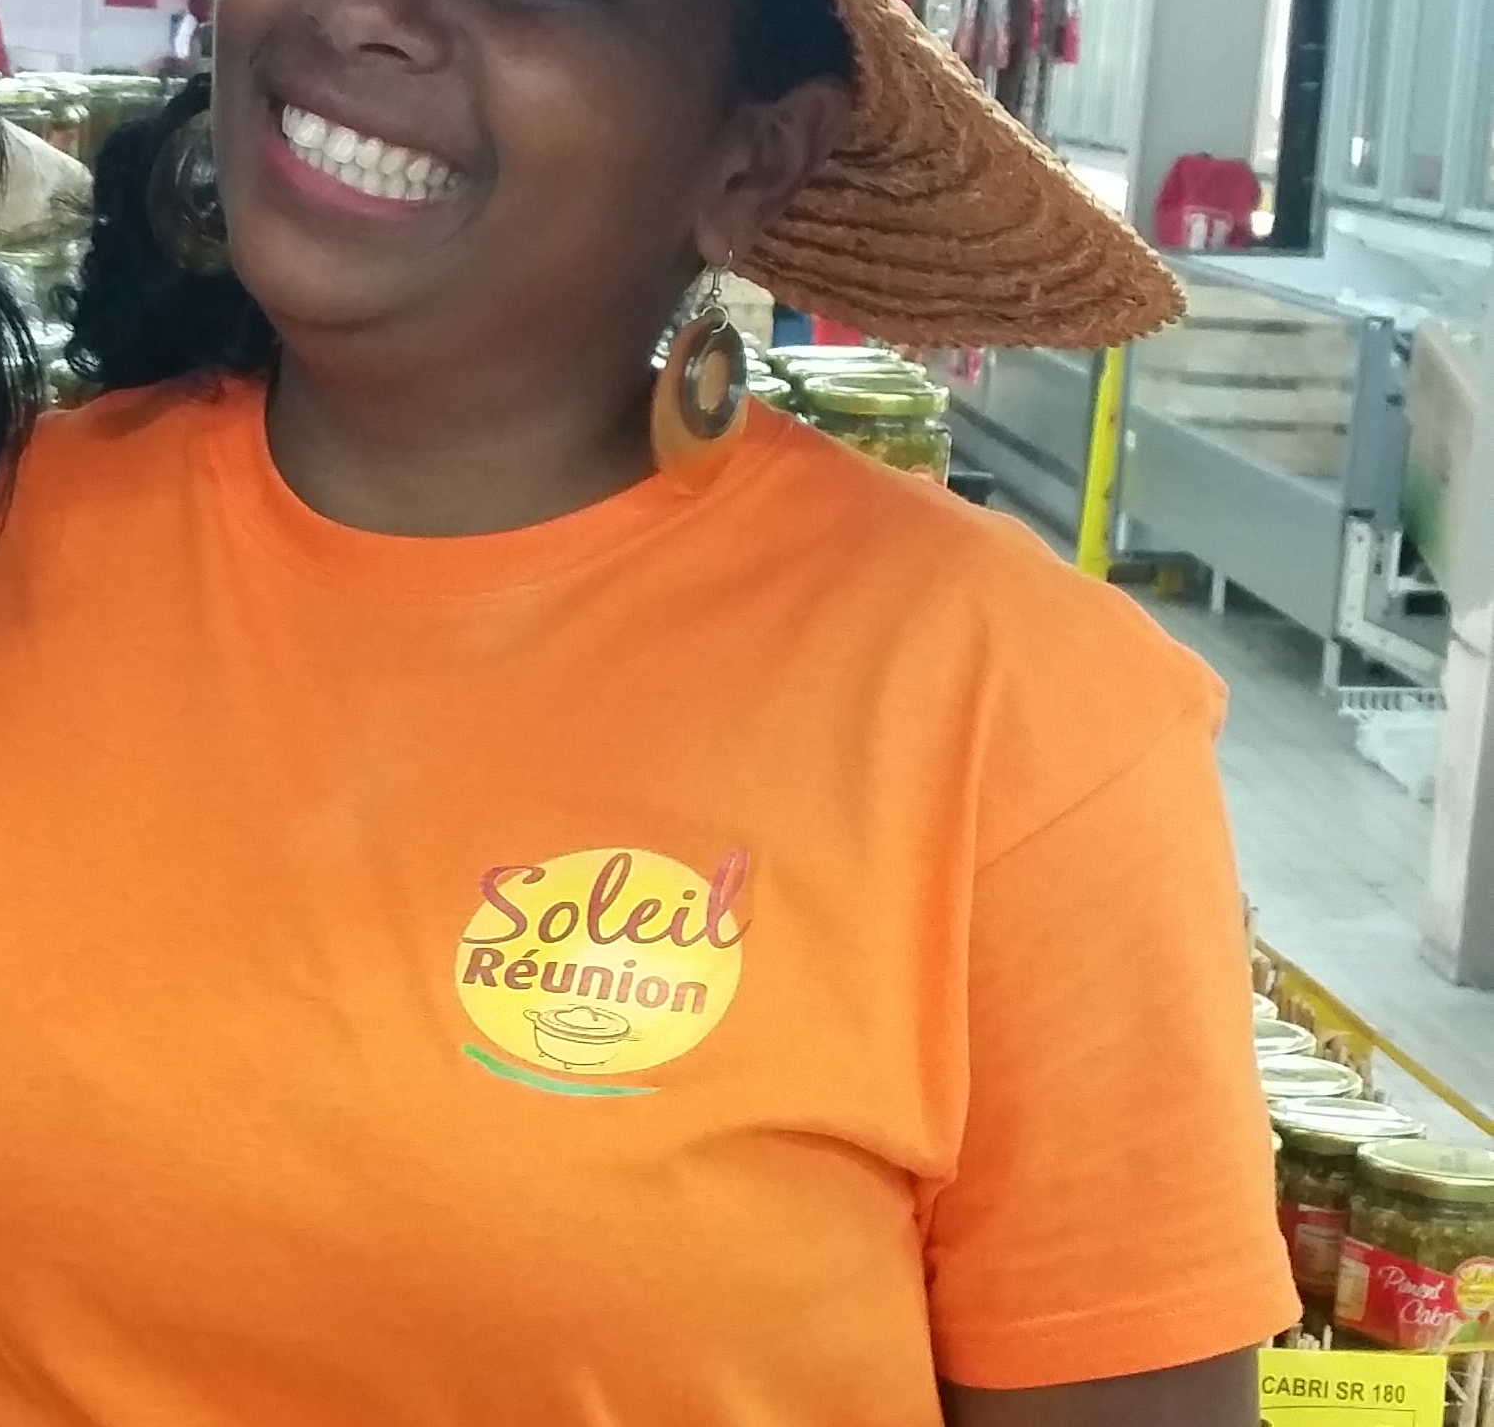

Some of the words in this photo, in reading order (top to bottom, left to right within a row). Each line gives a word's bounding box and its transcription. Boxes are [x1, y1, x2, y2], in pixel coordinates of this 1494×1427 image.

[459, 844, 753, 950] Soleil
[462, 947, 709, 1015] Réunion
[1261, 1375, 1330, 1400] CABRI
[1336, 1380, 1366, 1403] SR
